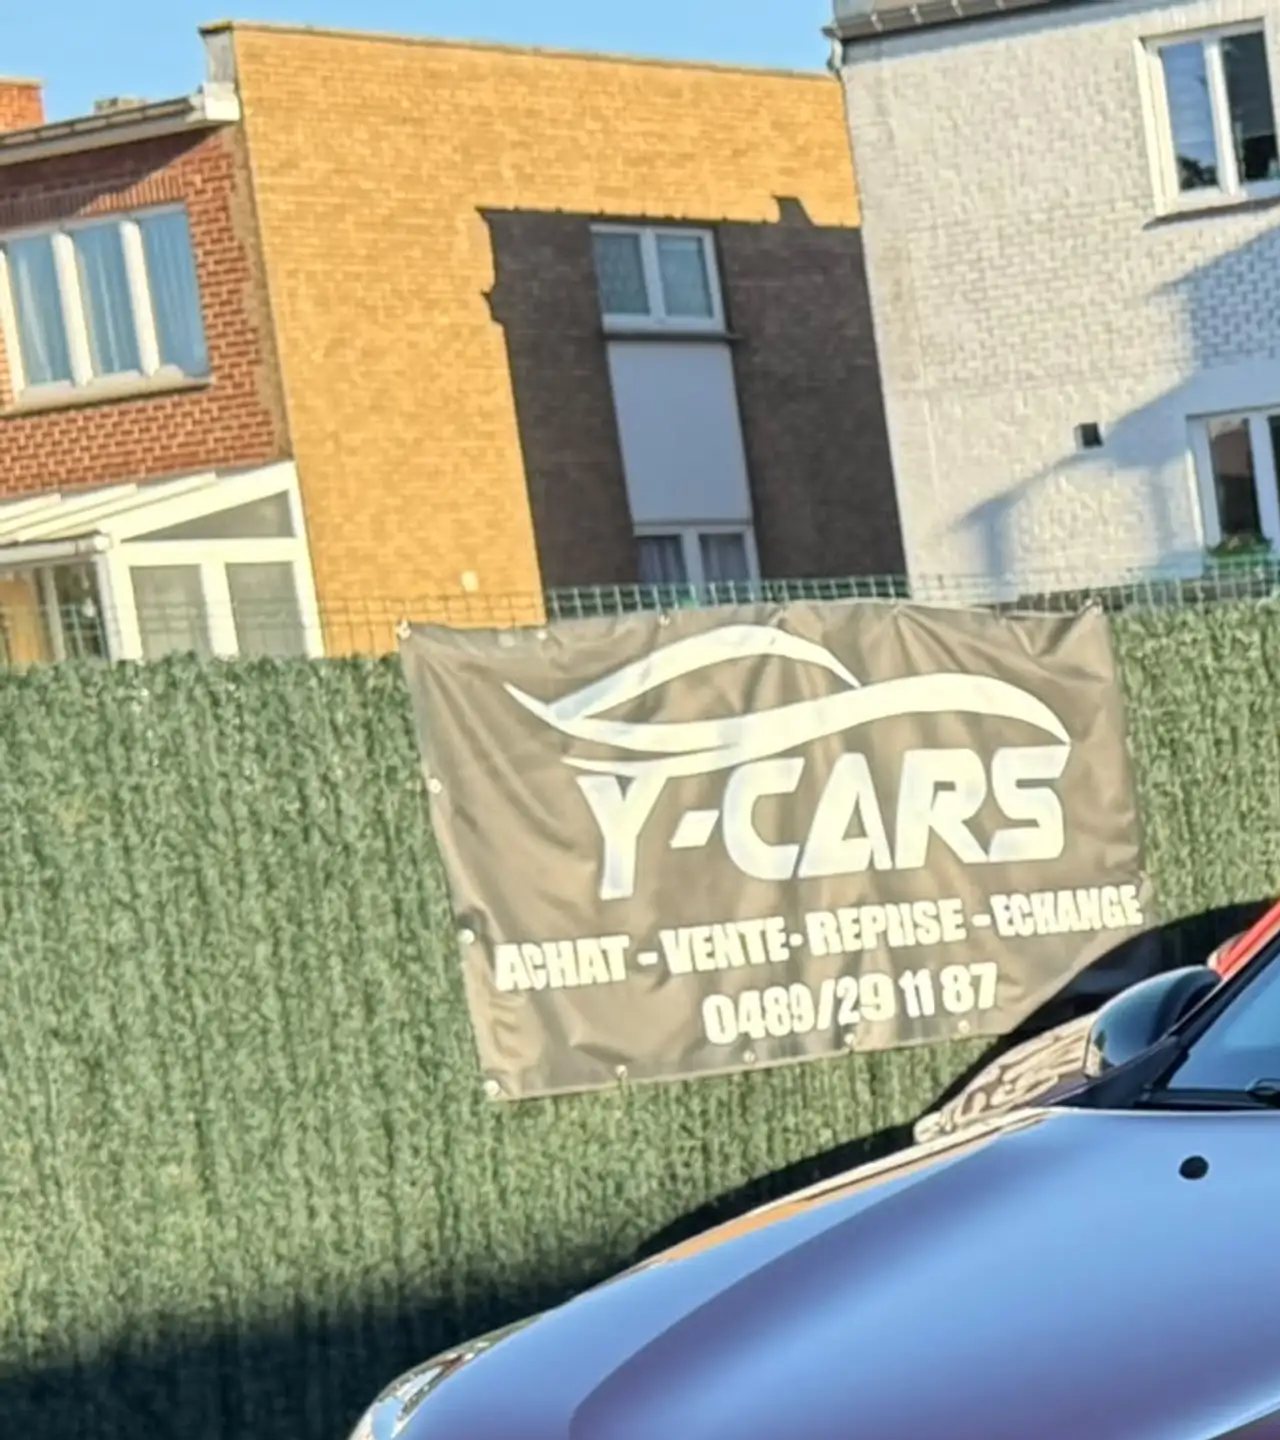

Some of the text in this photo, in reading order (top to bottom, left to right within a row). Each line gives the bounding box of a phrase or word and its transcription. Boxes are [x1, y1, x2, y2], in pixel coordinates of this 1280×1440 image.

[575, 746, 1071, 900] Y-CARS
[494, 935, 630, 992] ACHAT
[659, 916, 790, 975] VENTE
[990, 884, 1144, 938] ECHANGE
[702, 962, 999, 1046] 0489/29 11 87
